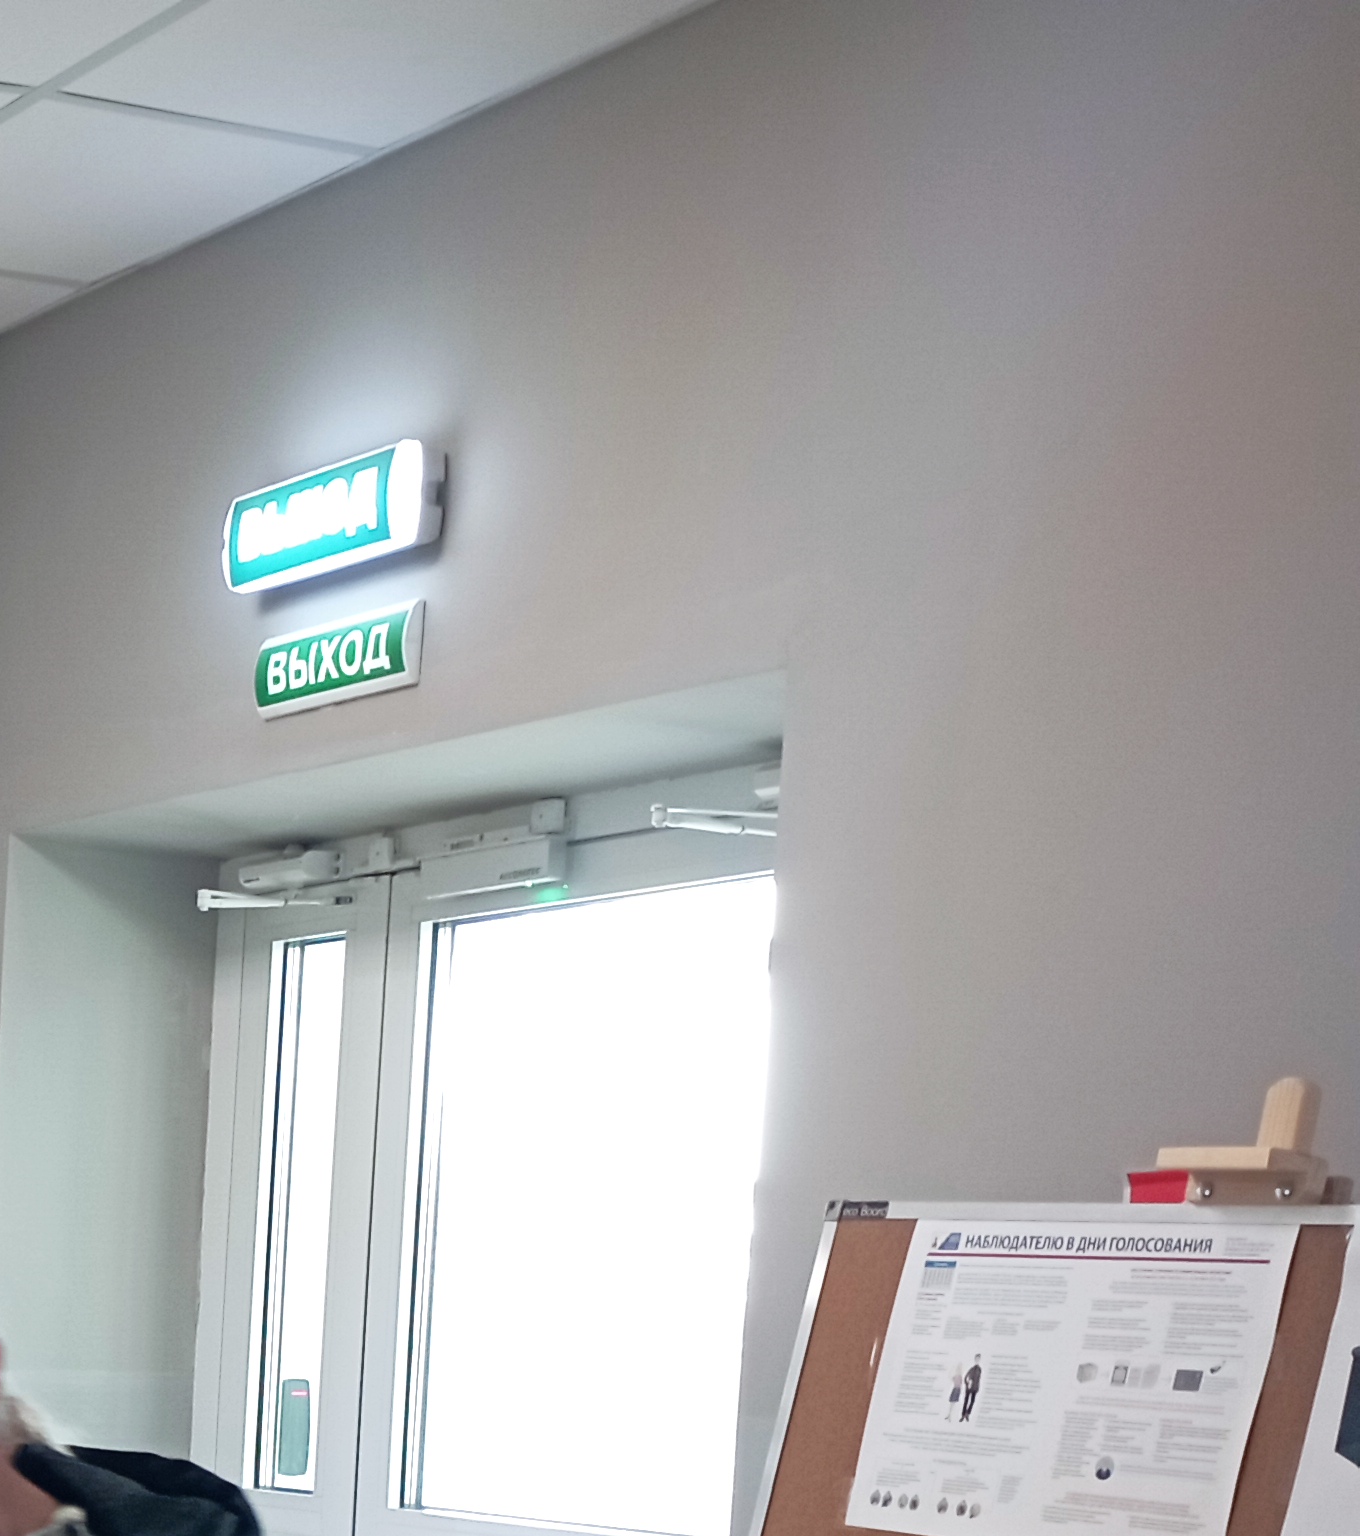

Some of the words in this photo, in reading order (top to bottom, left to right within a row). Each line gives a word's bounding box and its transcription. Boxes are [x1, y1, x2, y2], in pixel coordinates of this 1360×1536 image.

[267, 622, 391, 696] ВЫХОД
[964, 1235, 1064, 1252] НАБЛЮДАТЕЛЮ
[1066, 1237, 1074, 1250] В
[1076, 1237, 1108, 1253] ДНИ
[1108, 1238, 1213, 1253] ГОЛОСОВАНИЯ
